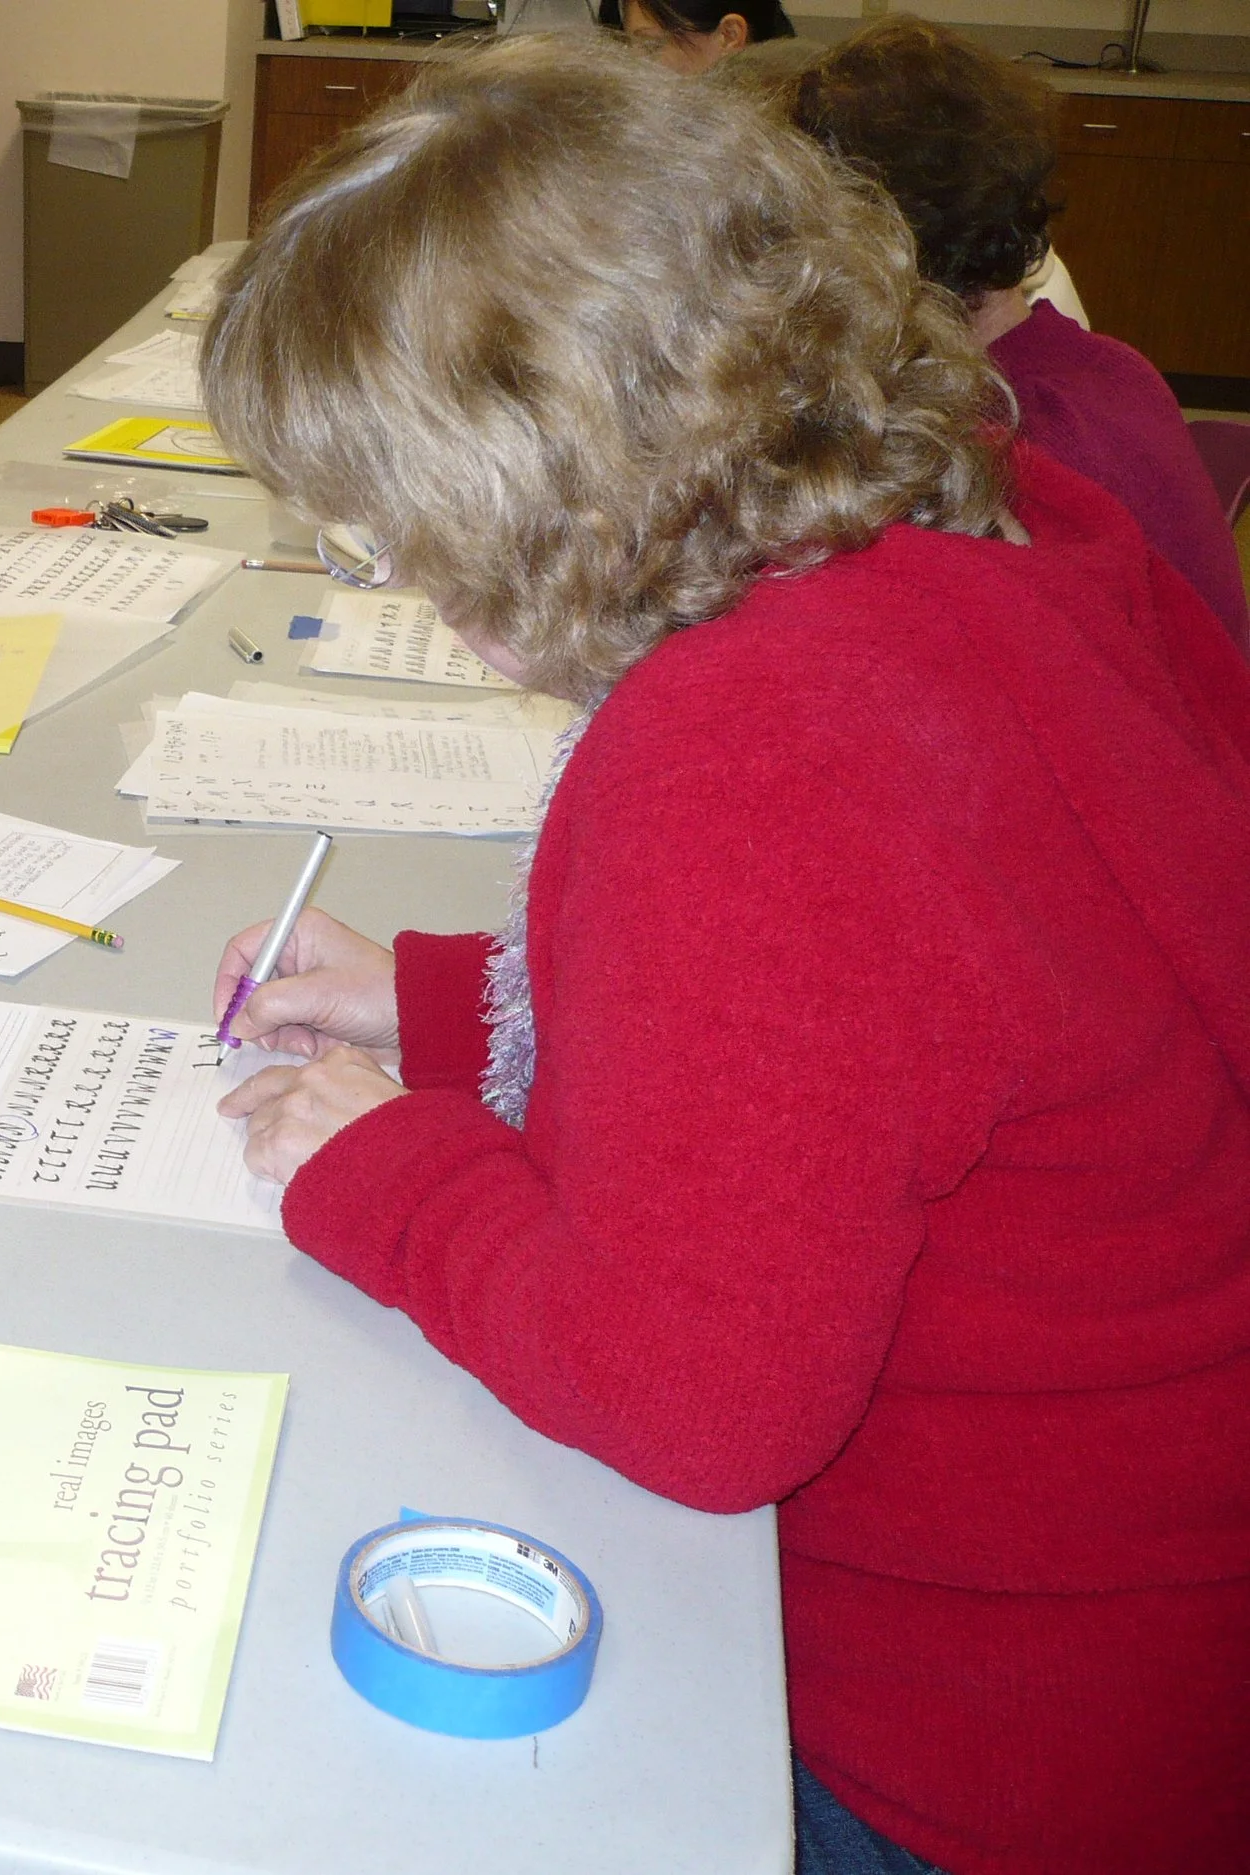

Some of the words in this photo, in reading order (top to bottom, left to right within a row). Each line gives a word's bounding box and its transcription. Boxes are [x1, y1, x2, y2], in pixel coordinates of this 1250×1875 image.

[56, 1400, 112, 1467] images
[124, 1385, 192, 1455] pad
[49, 1472, 85, 1512] real
[168, 1479, 216, 1613] portfolio
[206, 1391, 237, 1463] series
[84, 1461, 184, 1602] tracing
[543, 1558, 559, 1577] 3M
